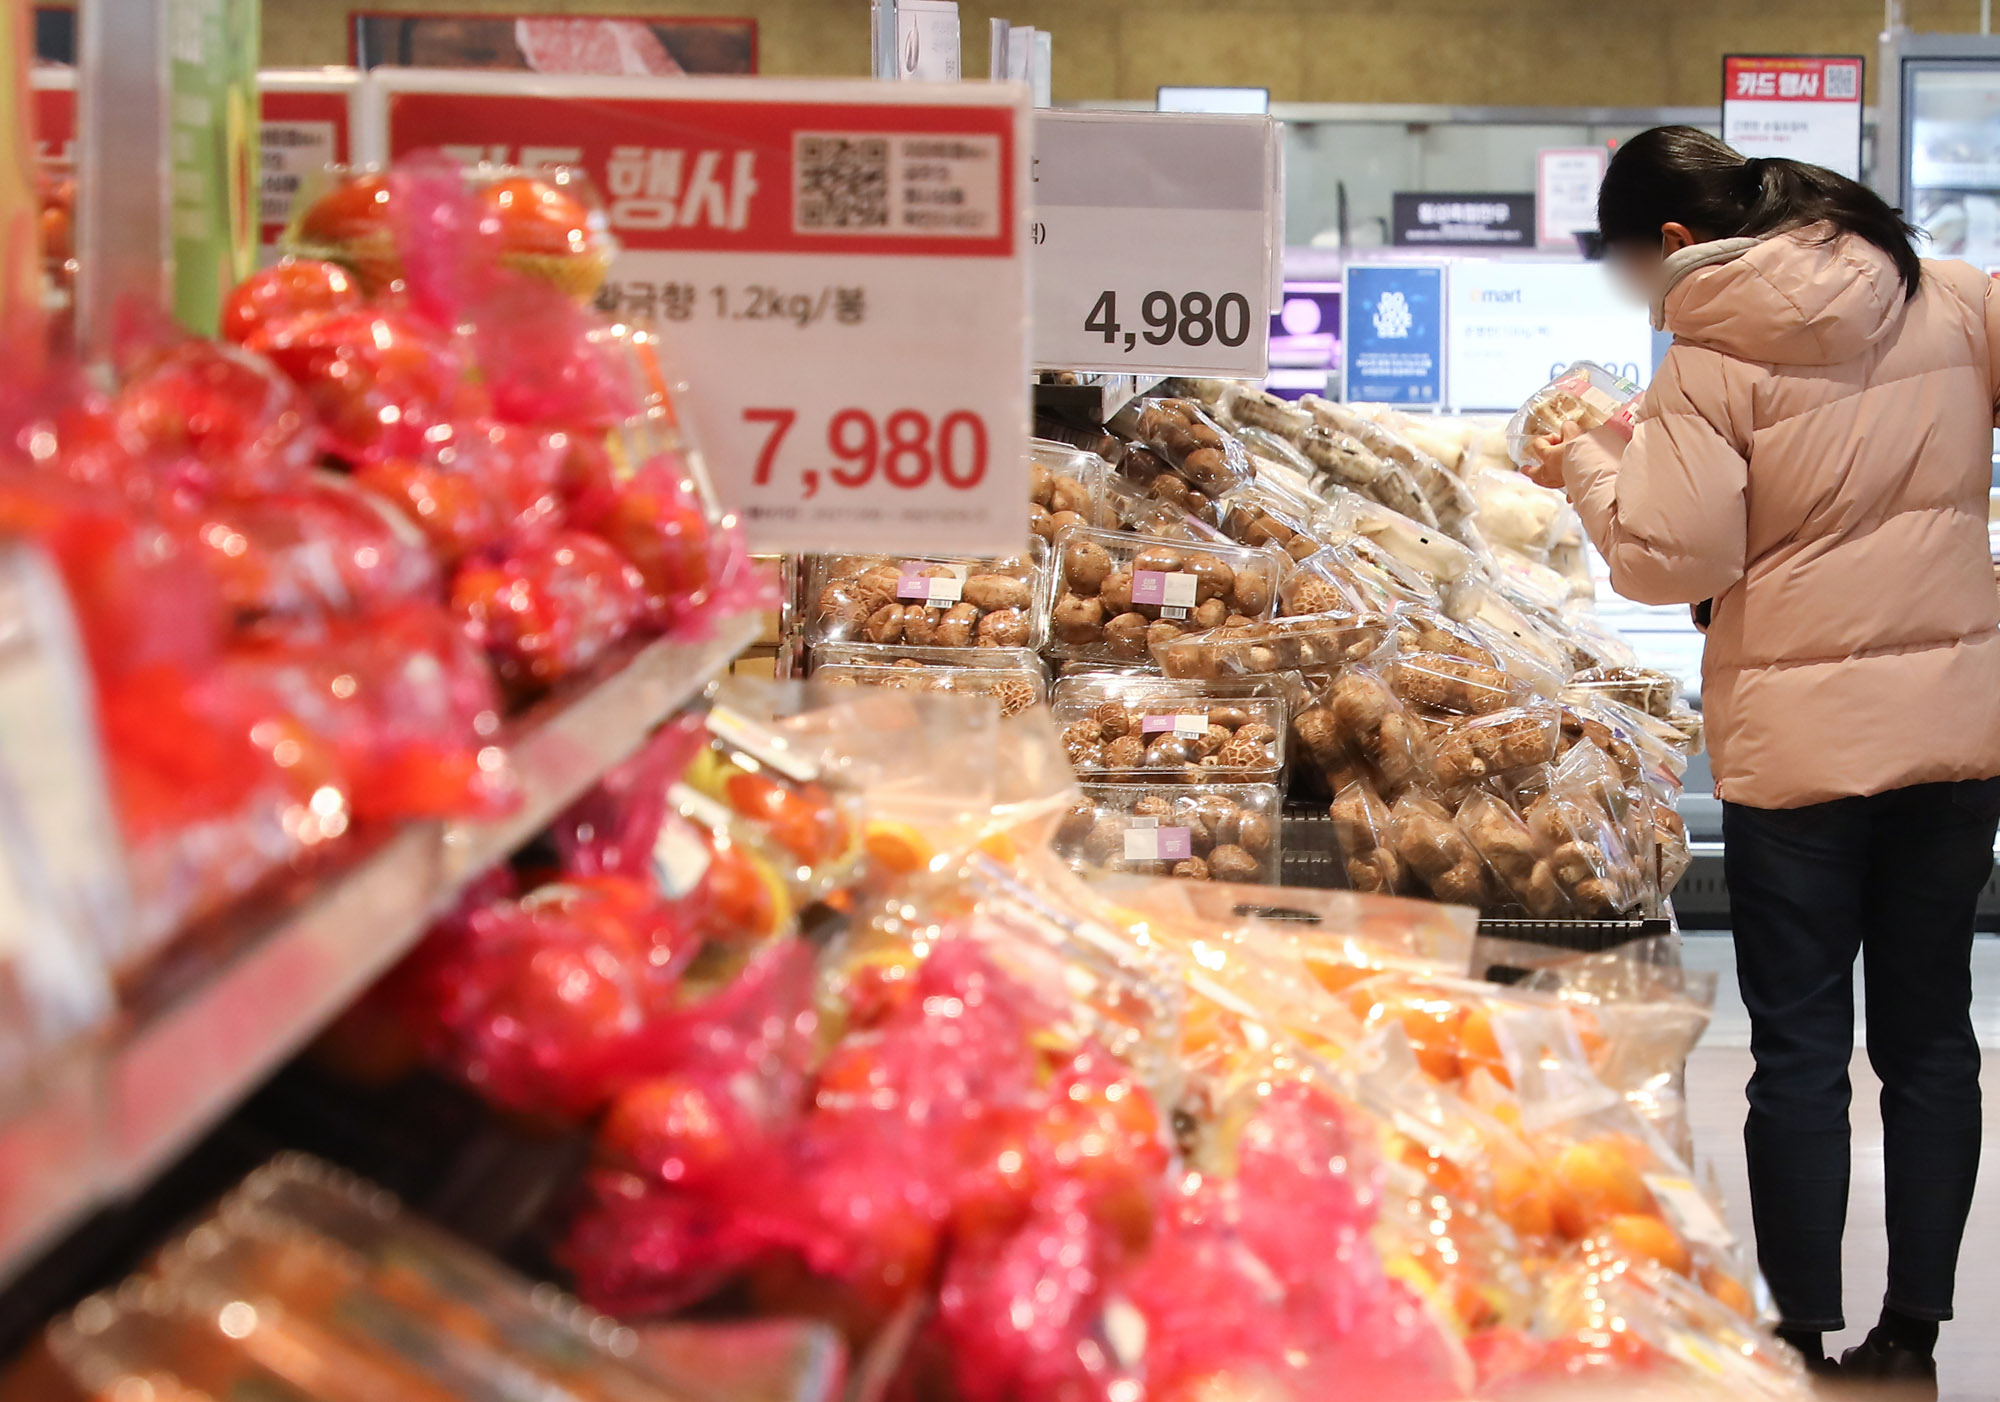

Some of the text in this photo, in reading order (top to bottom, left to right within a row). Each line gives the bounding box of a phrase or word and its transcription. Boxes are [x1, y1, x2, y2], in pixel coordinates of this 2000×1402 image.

[1736, 72, 1819, 97] 카드 행사
[605, 146, 760, 230] 행사
[710, 284, 867, 327] 1.2kg/봉
[1084, 290, 1251, 353] 4,980
[1469, 288, 1522, 303] emart
[741, 407, 989, 499] 7,980
